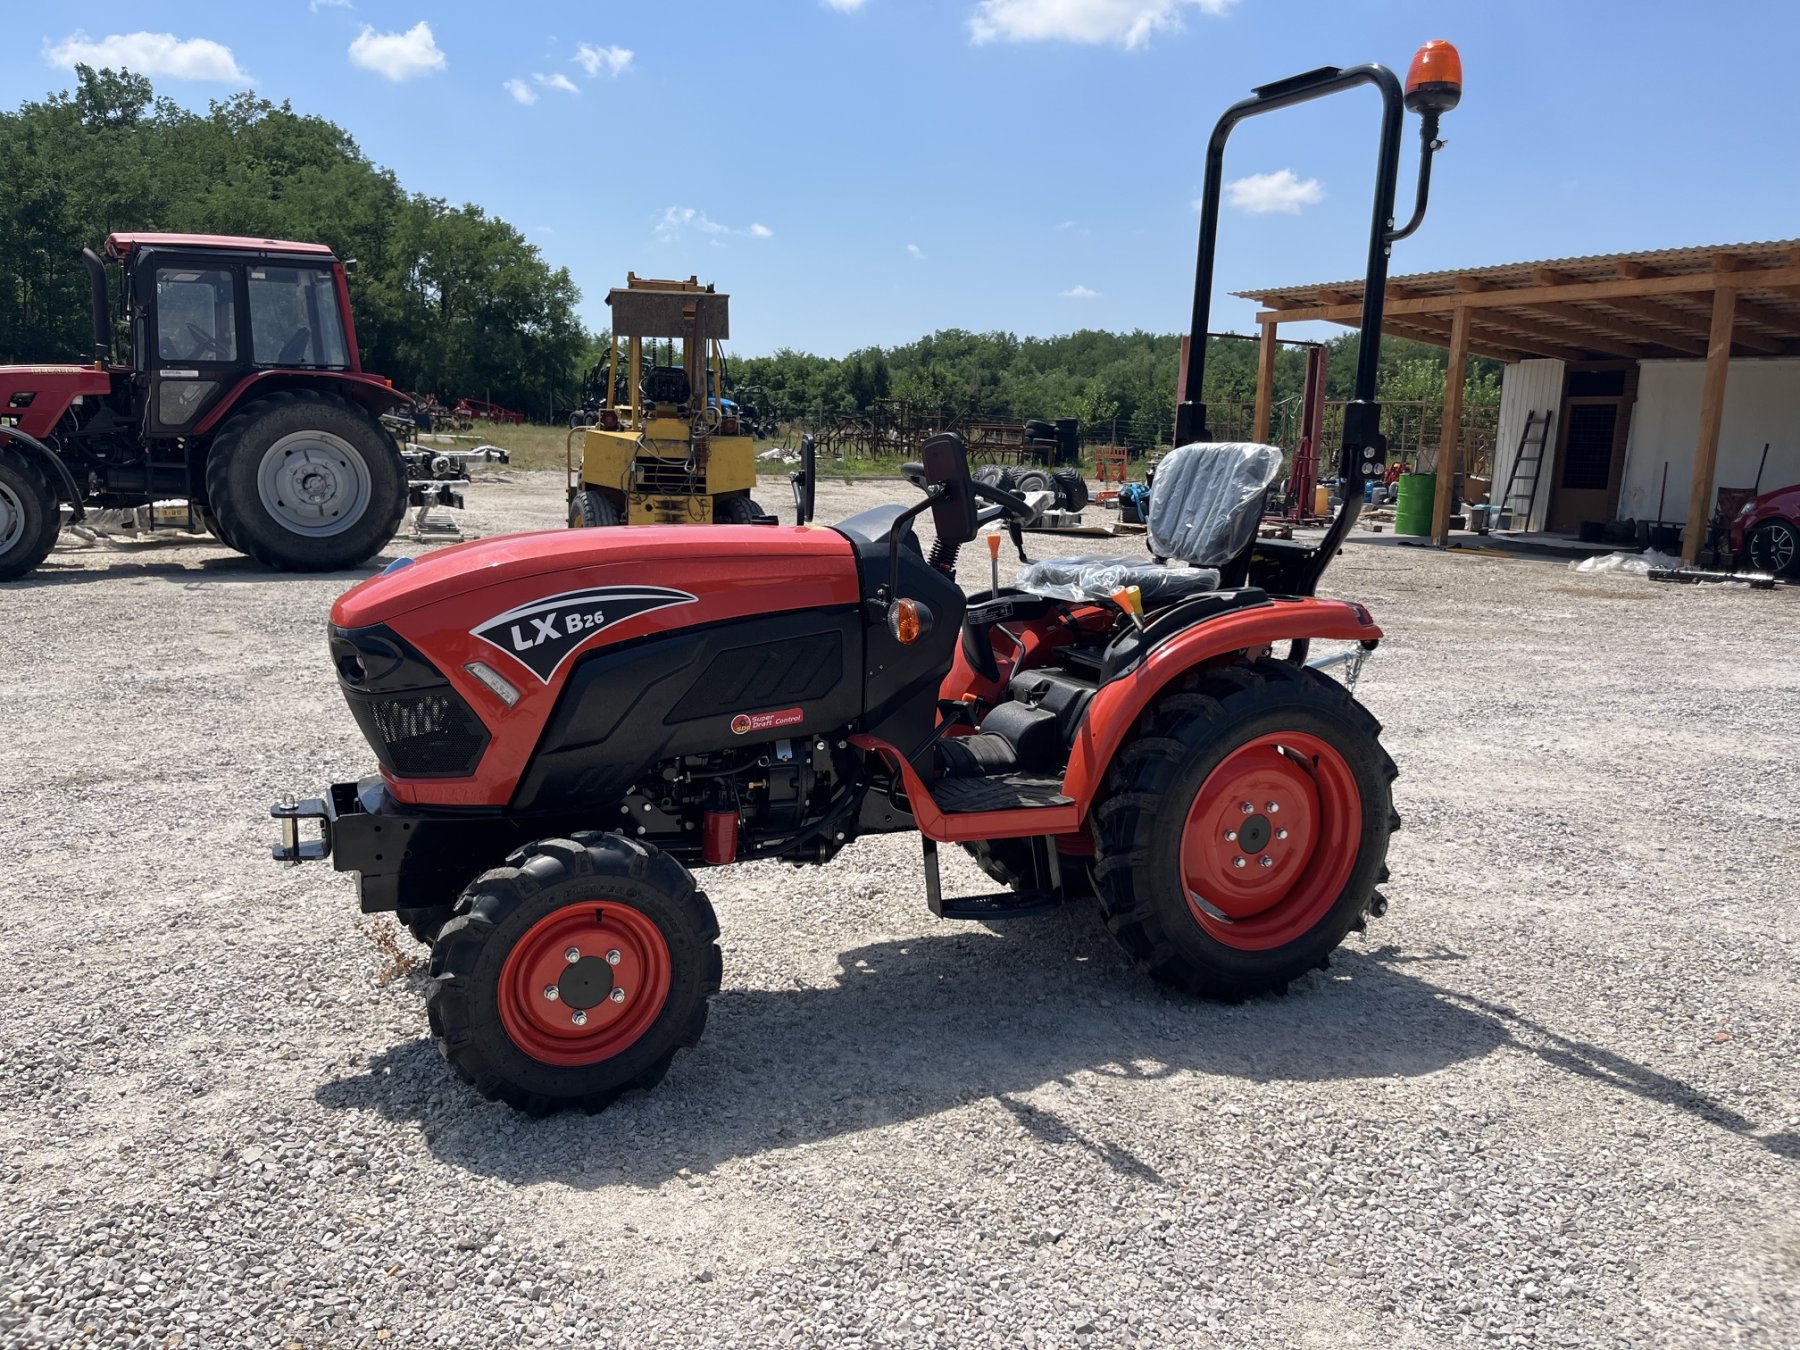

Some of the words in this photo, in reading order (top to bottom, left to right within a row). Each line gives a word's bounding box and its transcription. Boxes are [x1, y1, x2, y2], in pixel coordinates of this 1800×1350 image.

[510, 612, 563, 651] LX
[565, 610, 605, 634] B26
[752, 720, 773, 728] Draft
[775, 715, 801, 724] Control
